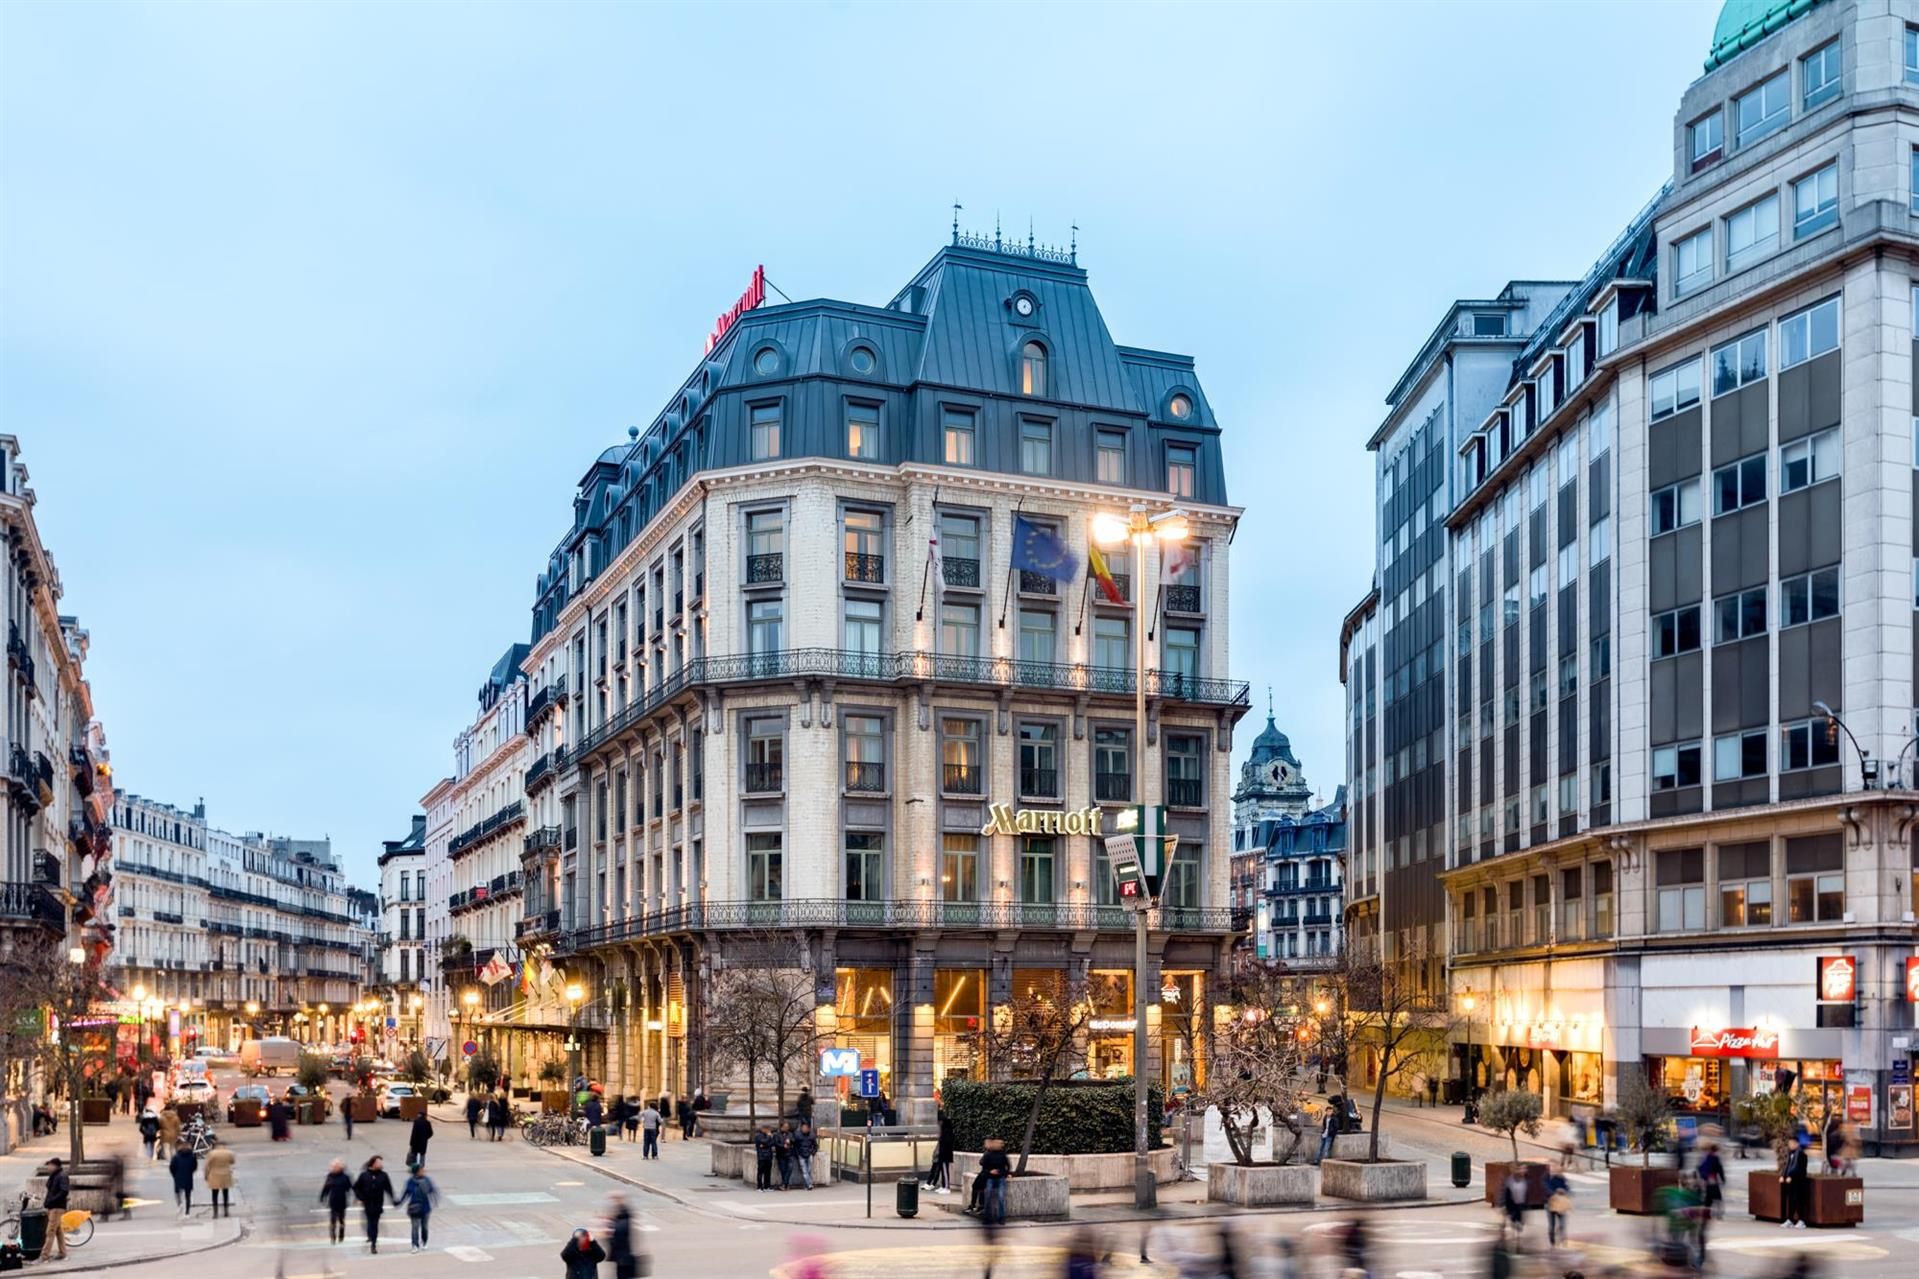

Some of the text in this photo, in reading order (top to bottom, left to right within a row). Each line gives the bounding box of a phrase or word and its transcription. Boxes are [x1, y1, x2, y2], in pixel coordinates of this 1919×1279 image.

[980, 802, 1103, 836] Marriott
[1719, 1032, 1778, 1049] Pizza Hut
